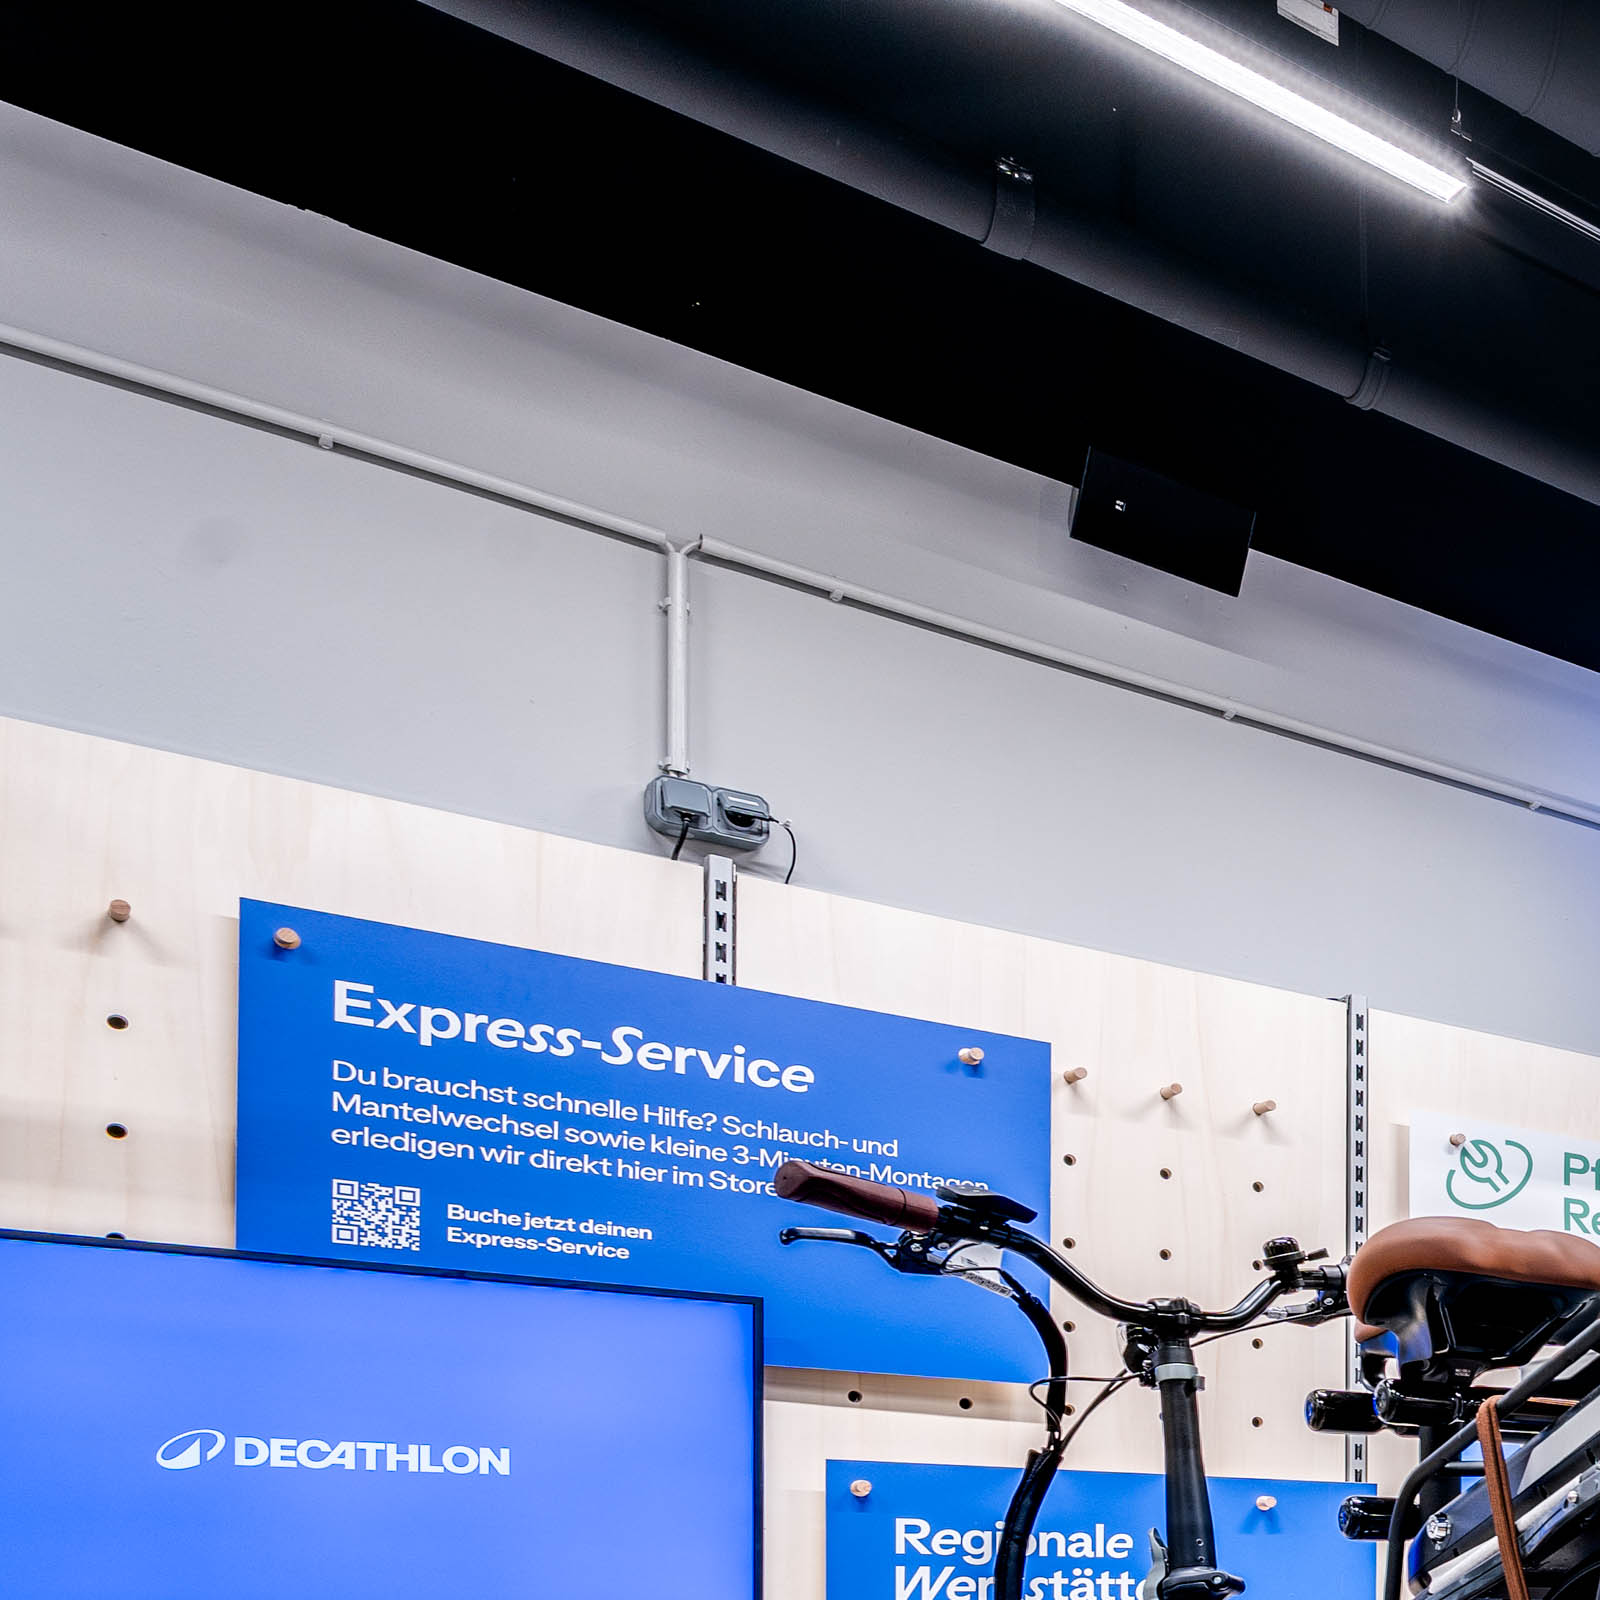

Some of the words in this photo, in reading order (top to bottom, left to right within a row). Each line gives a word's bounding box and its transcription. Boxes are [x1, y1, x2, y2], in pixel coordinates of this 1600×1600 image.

[334, 979, 815, 1093] Express-Service
[332, 1060, 376, 1086] Du
[384, 1067, 517, 1105] brauchst
[523, 1092, 638, 1121] schnelle
[644, 1104, 717, 1132] Hilfe?
[722, 1116, 848, 1149] Schlauch-
[852, 1139, 898, 1158] und
[332, 1092, 558, 1140] Mantelwechsel
[565, 1127, 645, 1151] sowie
[650, 1133, 729, 1162] kleine
[331, 1127, 474, 1160] erledigen
[480, 1145, 525, 1165] wir
[529, 1150, 612, 1177] direkt
[617, 1159, 668, 1184] hier
[672, 1165, 704, 1187] im
[447, 1204, 521, 1227] Buche
[522, 1212, 576, 1233] jetzt
[579, 1218, 653, 1240] deinen
[447, 1227, 630, 1260] Express-Service
[234, 1436, 510, 1475] DECATHLON
